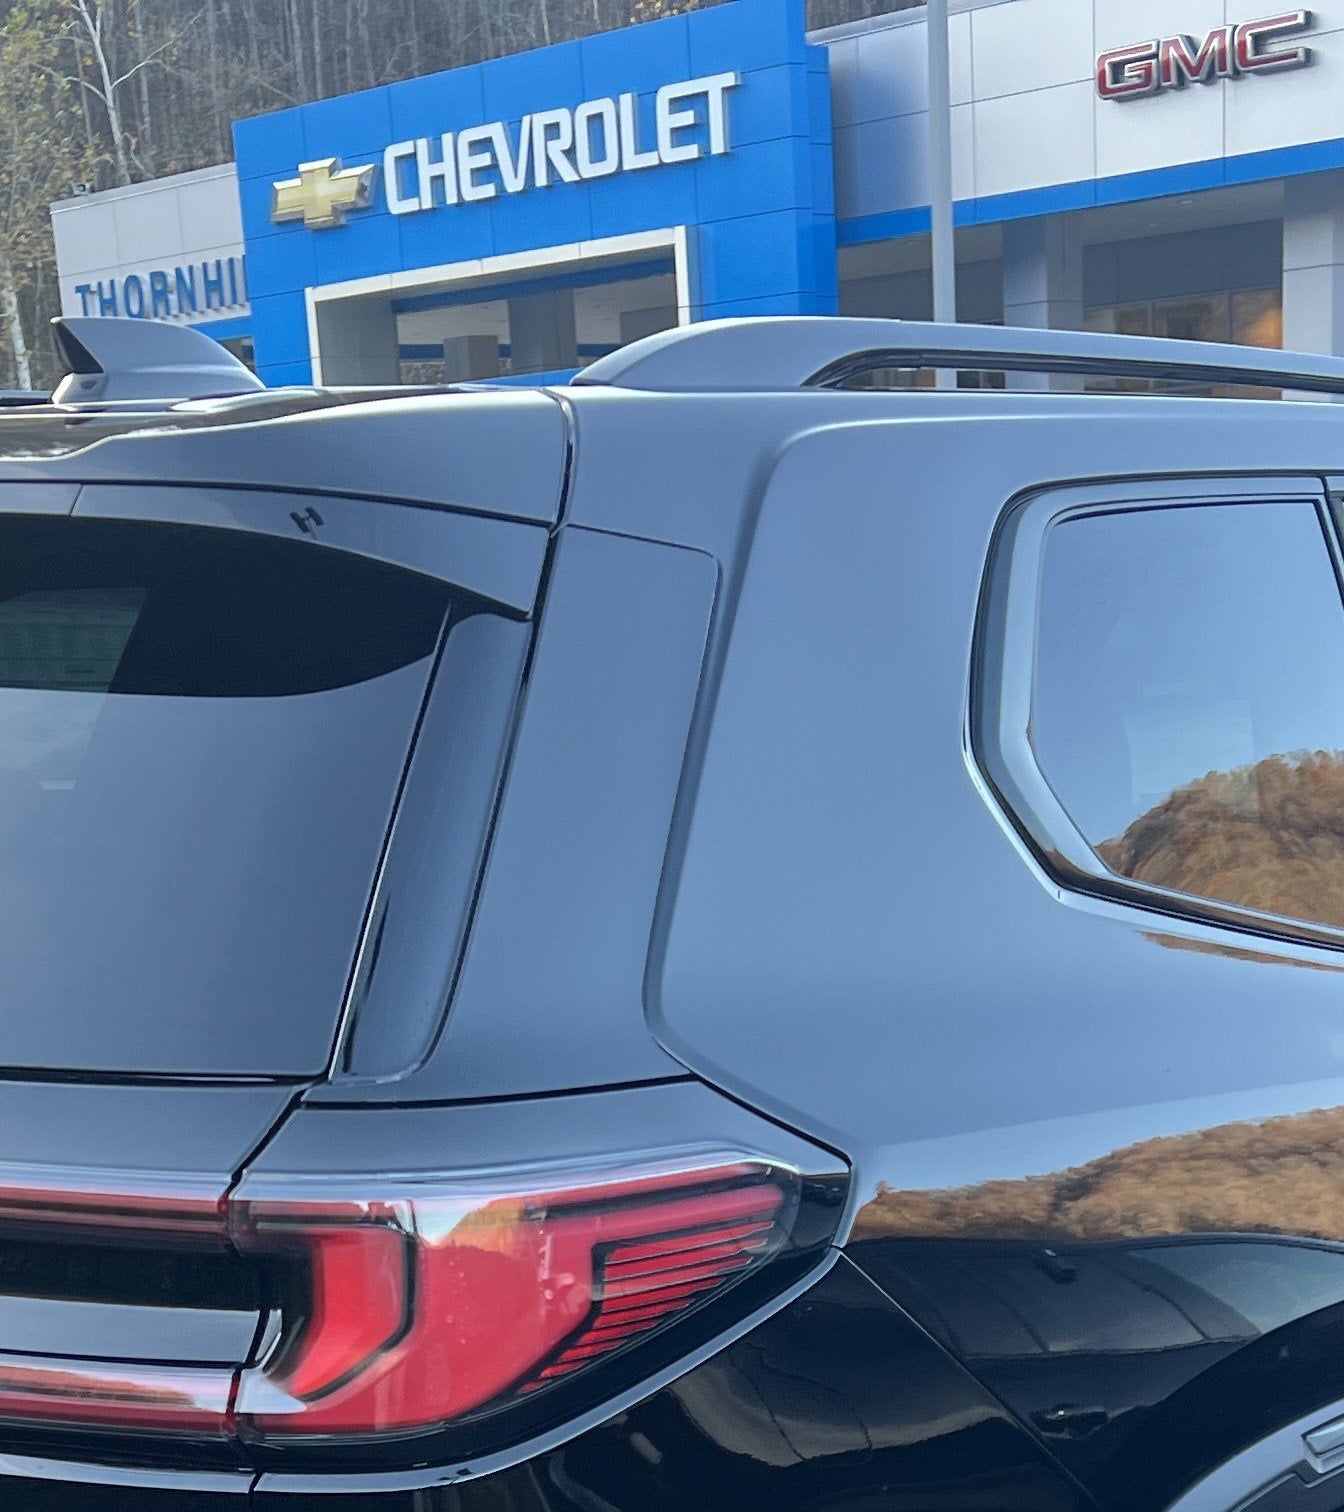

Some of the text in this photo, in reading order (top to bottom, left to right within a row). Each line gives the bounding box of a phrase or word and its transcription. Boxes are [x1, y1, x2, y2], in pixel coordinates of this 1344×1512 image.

[1096, 9, 1316, 102] GMC
[383, 71, 741, 215] CHEVROLET
[74, 254, 248, 319] THORNHI
